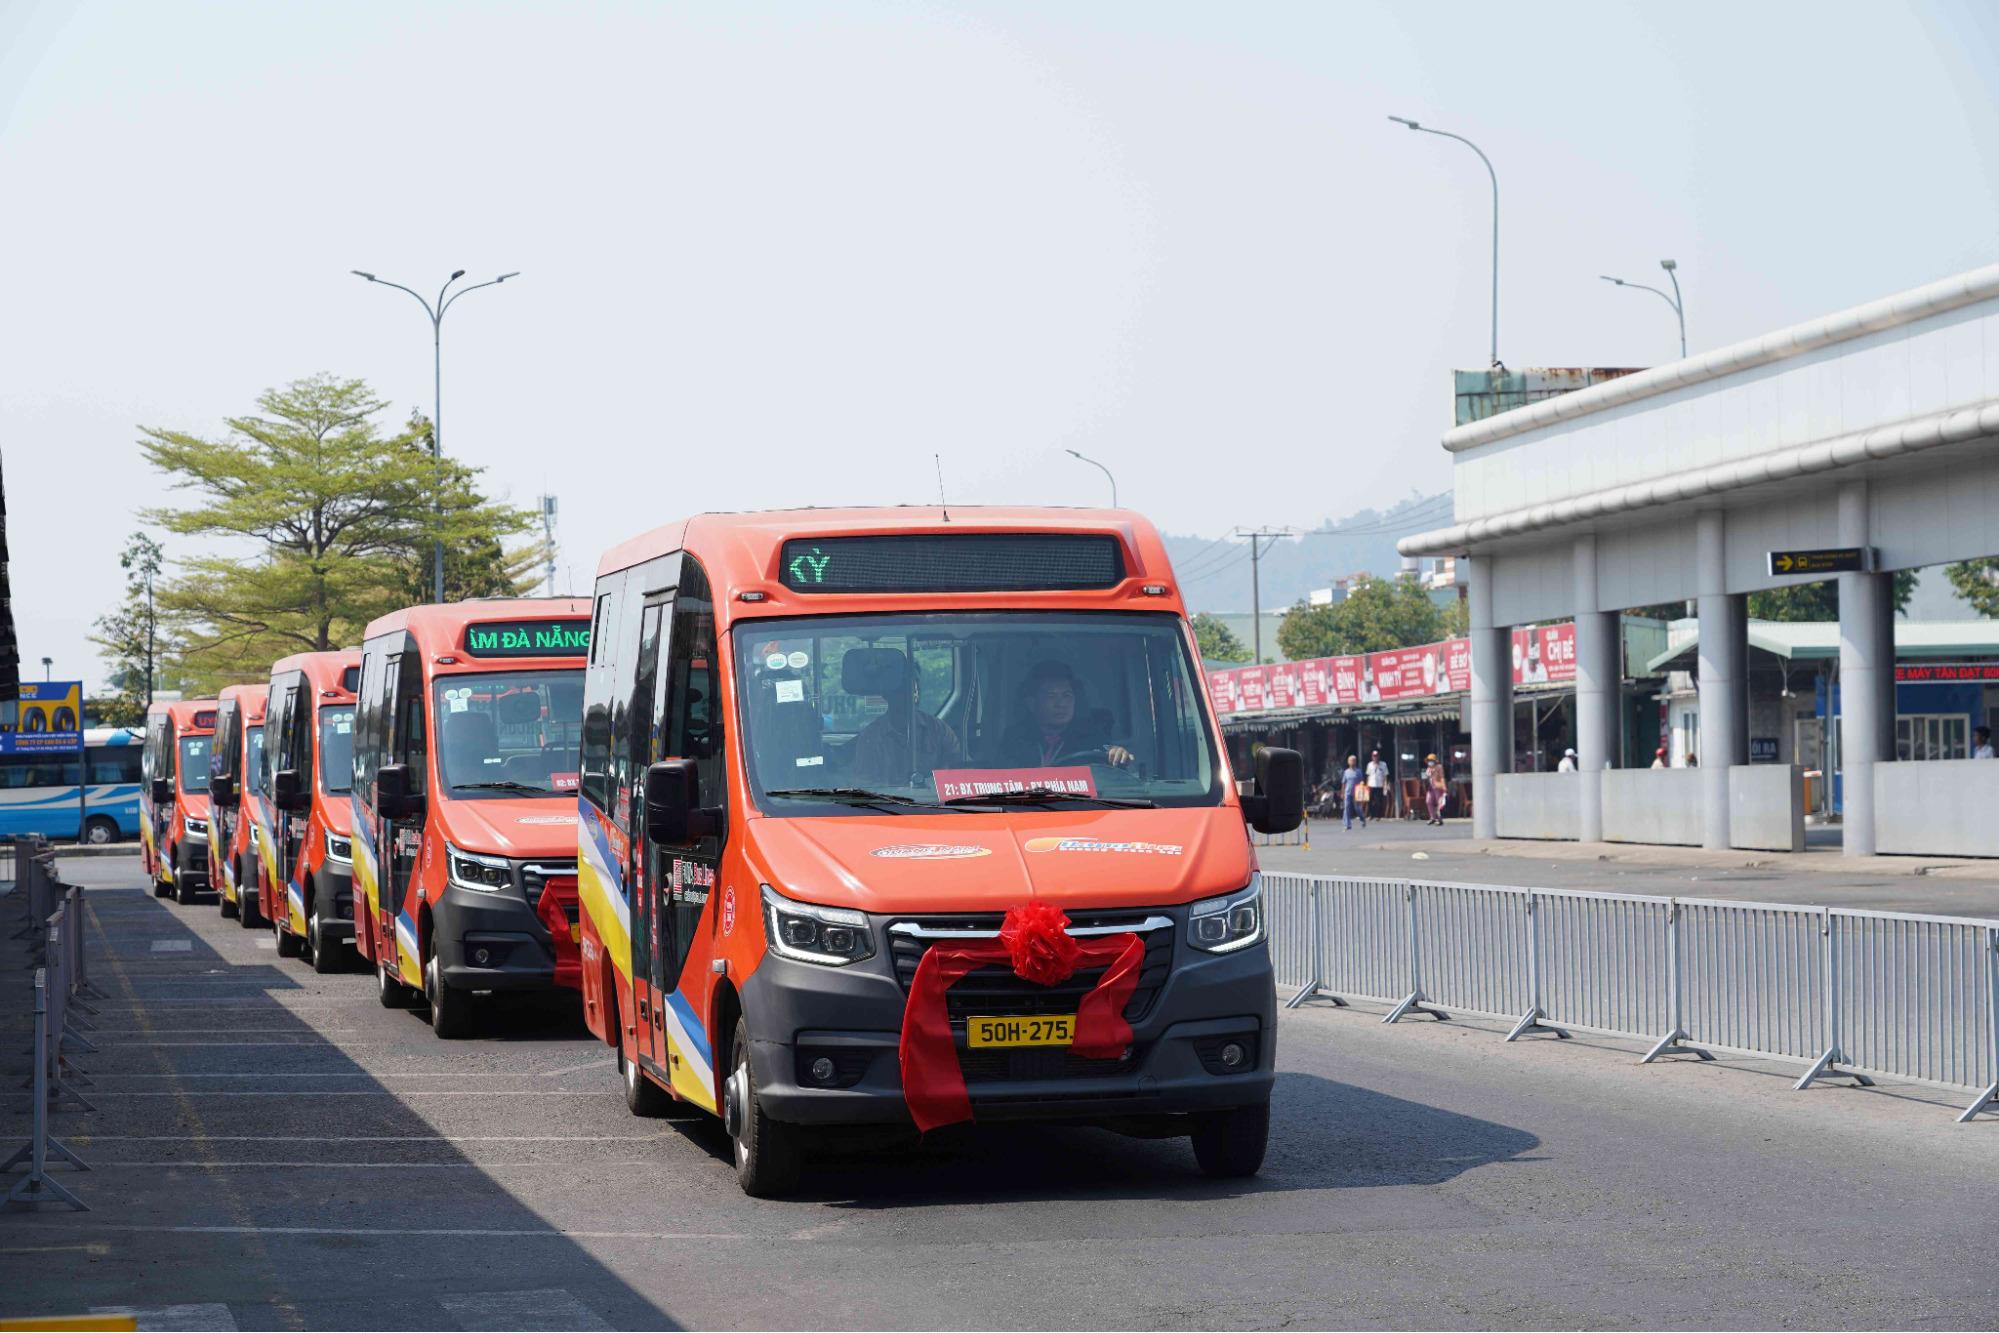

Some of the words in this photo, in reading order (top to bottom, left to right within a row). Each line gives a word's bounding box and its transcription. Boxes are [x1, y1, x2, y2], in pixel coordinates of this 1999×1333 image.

[502, 627, 531, 648] ĐÀ
[944, 783, 959, 797] 21:
[973, 781, 1003, 794] TRUNG
[1003, 779, 1024, 793] TÂM
[1043, 777, 1067, 793] PHÍA
[1068, 779, 1089, 793] NAM
